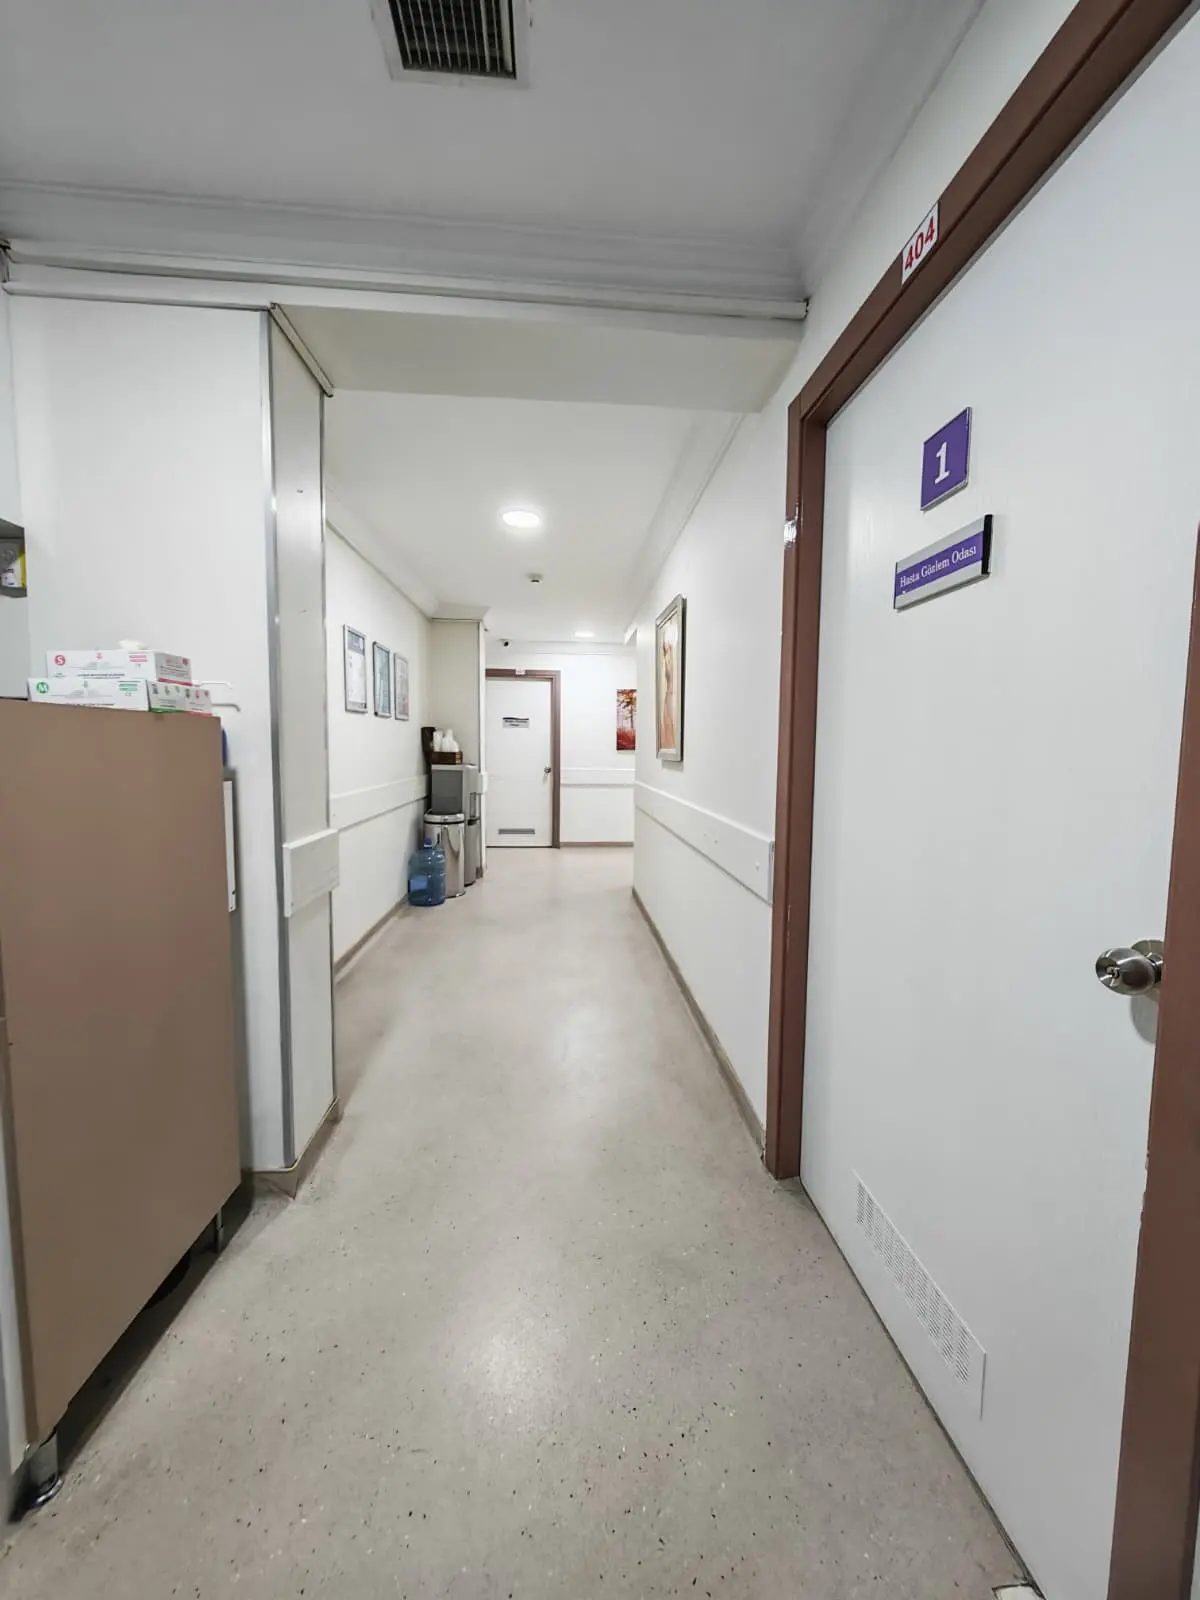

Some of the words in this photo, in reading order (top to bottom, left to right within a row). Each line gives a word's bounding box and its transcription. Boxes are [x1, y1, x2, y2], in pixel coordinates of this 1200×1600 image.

[904, 215, 935, 271] 404
[935, 441, 951, 485] 1
[900, 572, 920, 588] Hasta
[921, 558, 950, 578] Gözlem
[952, 545, 977, 564] Odası
[38, 683, 48, 693] M
